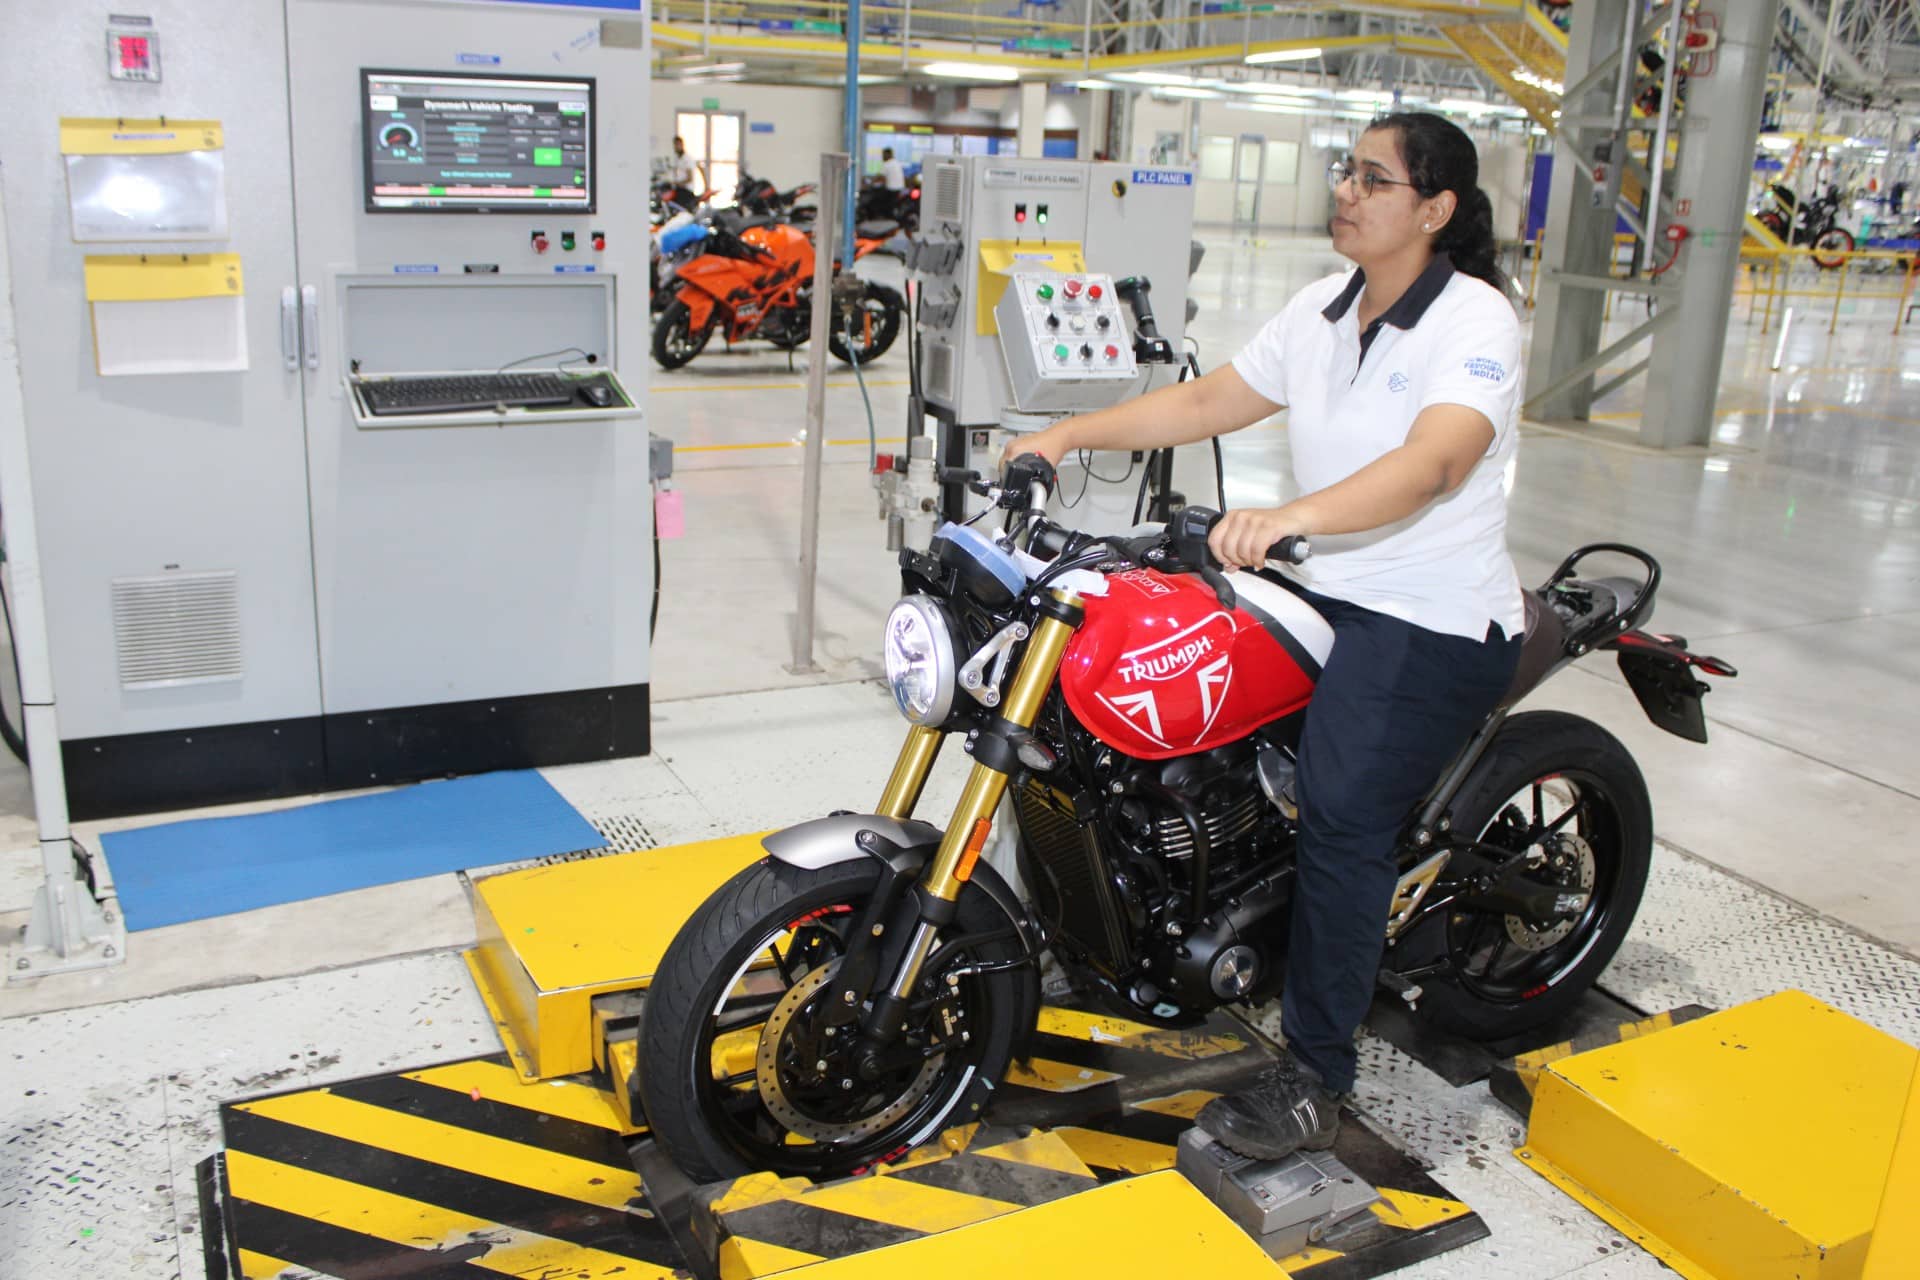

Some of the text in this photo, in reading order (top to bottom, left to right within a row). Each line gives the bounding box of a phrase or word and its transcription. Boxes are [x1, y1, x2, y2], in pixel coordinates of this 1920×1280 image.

[1137, 171, 1188, 185] PLC PANEL
[1469, 369, 1501, 383] INDIAN
[1118, 635, 1212, 683] TRIUMPH
